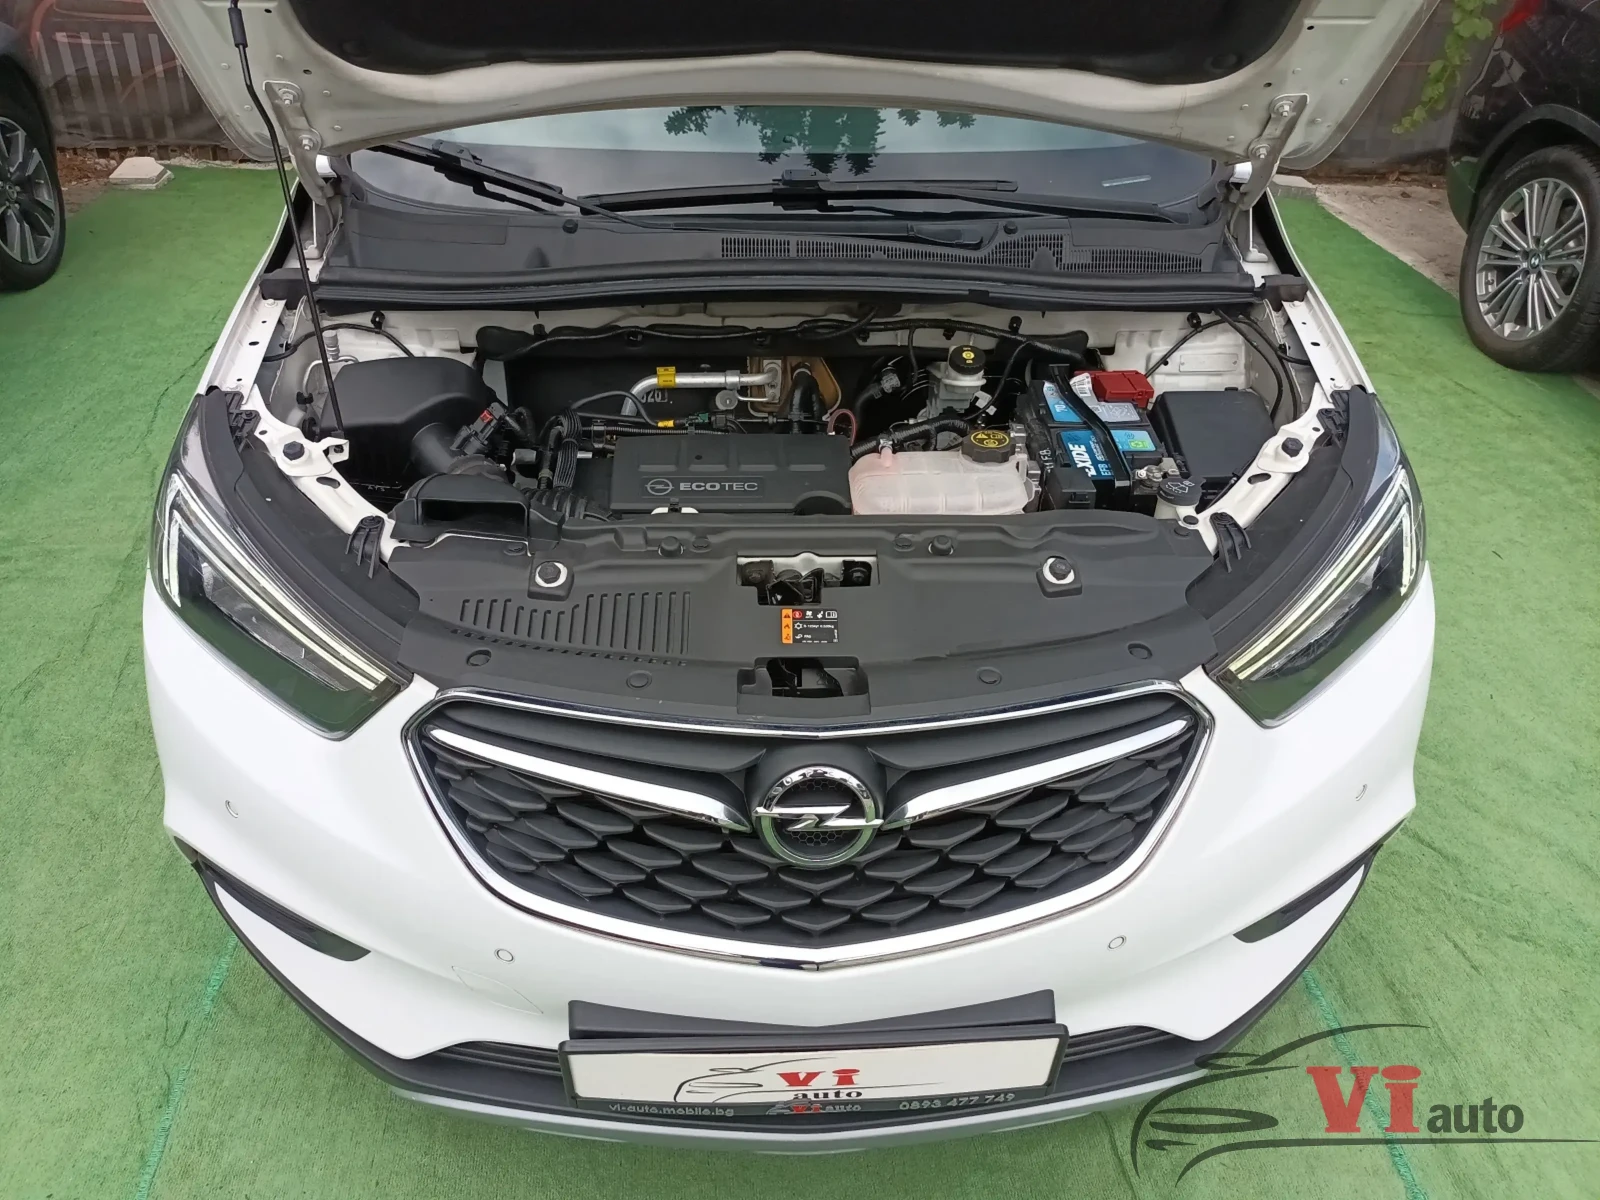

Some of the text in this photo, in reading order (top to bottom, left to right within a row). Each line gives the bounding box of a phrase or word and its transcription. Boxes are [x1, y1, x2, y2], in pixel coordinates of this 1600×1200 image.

[679, 482, 758, 492] ECOTEC
[793, 1089, 862, 1100] auto
[899, 1093, 1016, 1111] 0893 477 749
[825, 1103, 862, 1113] auto
